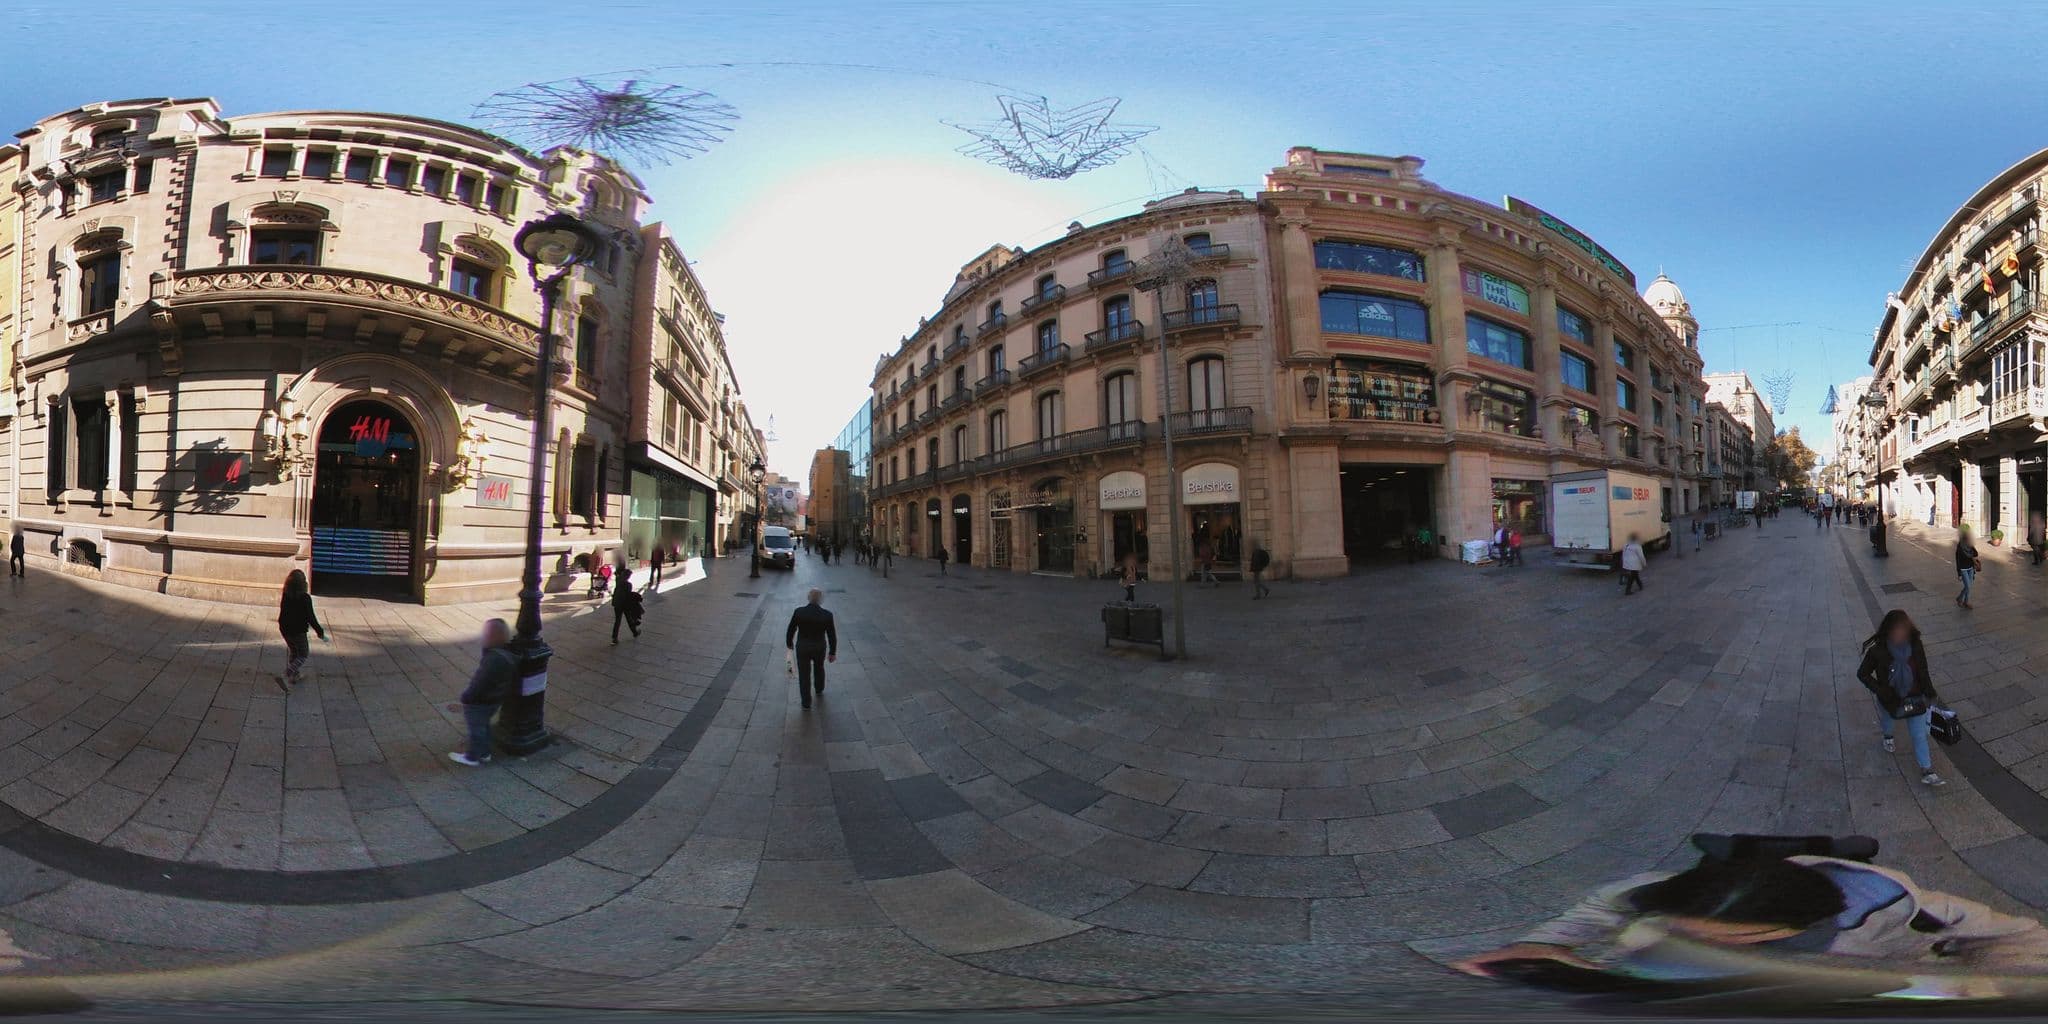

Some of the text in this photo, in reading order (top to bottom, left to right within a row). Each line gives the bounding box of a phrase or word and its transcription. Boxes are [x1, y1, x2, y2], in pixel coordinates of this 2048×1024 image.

[1485, 283, 1506, 296] THE
[1358, 311, 1394, 322] adidas
[349, 415, 391, 445] H&M
[483, 480, 510, 502] H&M
[1187, 479, 1233, 494] Bershka
[1102, 487, 1142, 500] Bershka
[1633, 487, 1650, 500] SEUR
